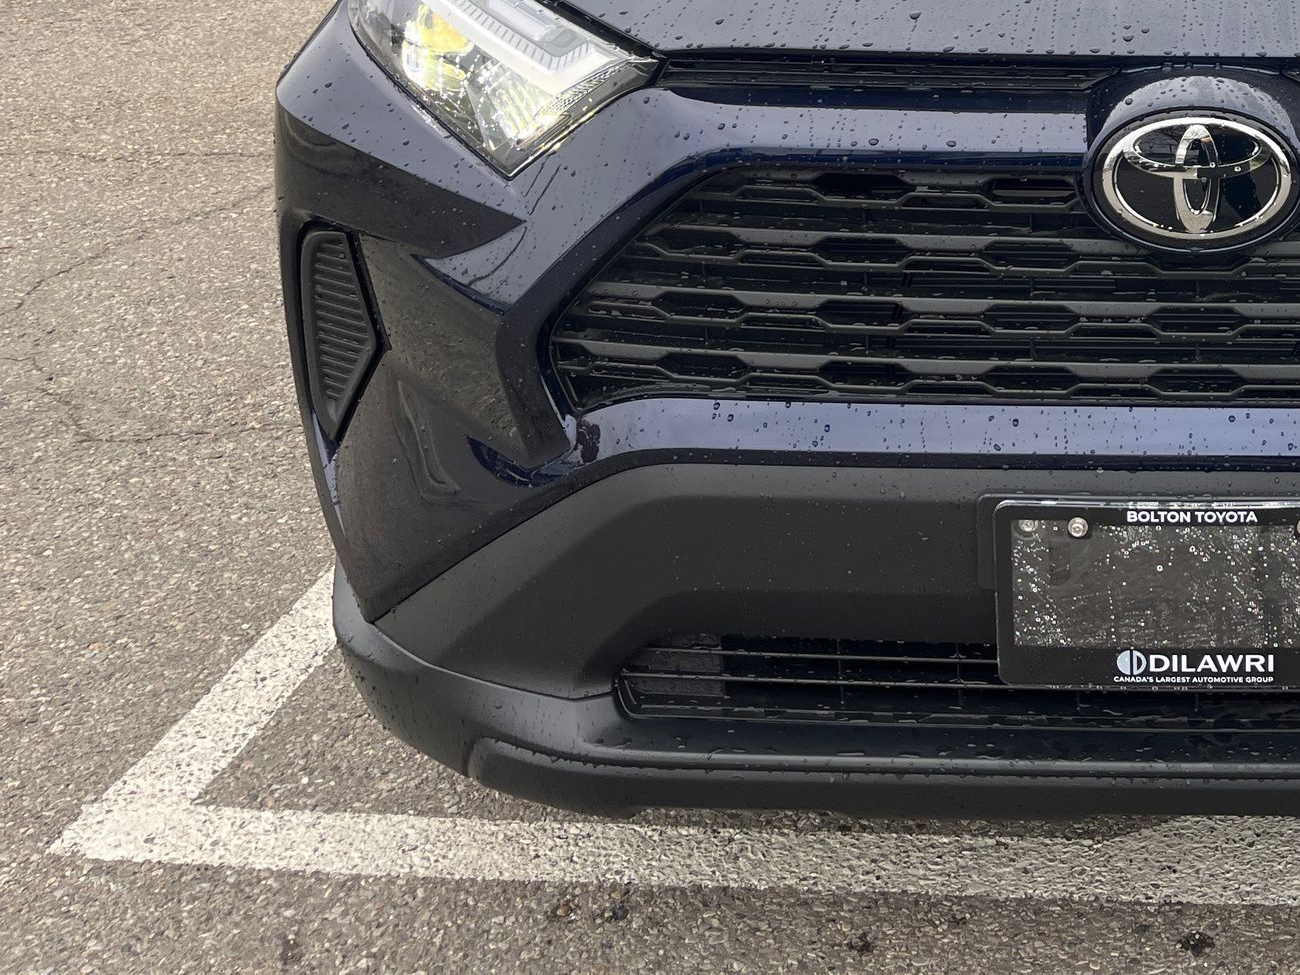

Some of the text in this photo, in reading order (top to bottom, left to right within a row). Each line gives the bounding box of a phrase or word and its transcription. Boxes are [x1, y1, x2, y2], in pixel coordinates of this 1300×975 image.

[1126, 510, 1258, 523] BOLTON TOYOTA
[1149, 654, 1275, 673] DILAWRI
[1113, 675, 1274, 684] CANADA'S LARGEST AUTOMOTIVE GROUP
